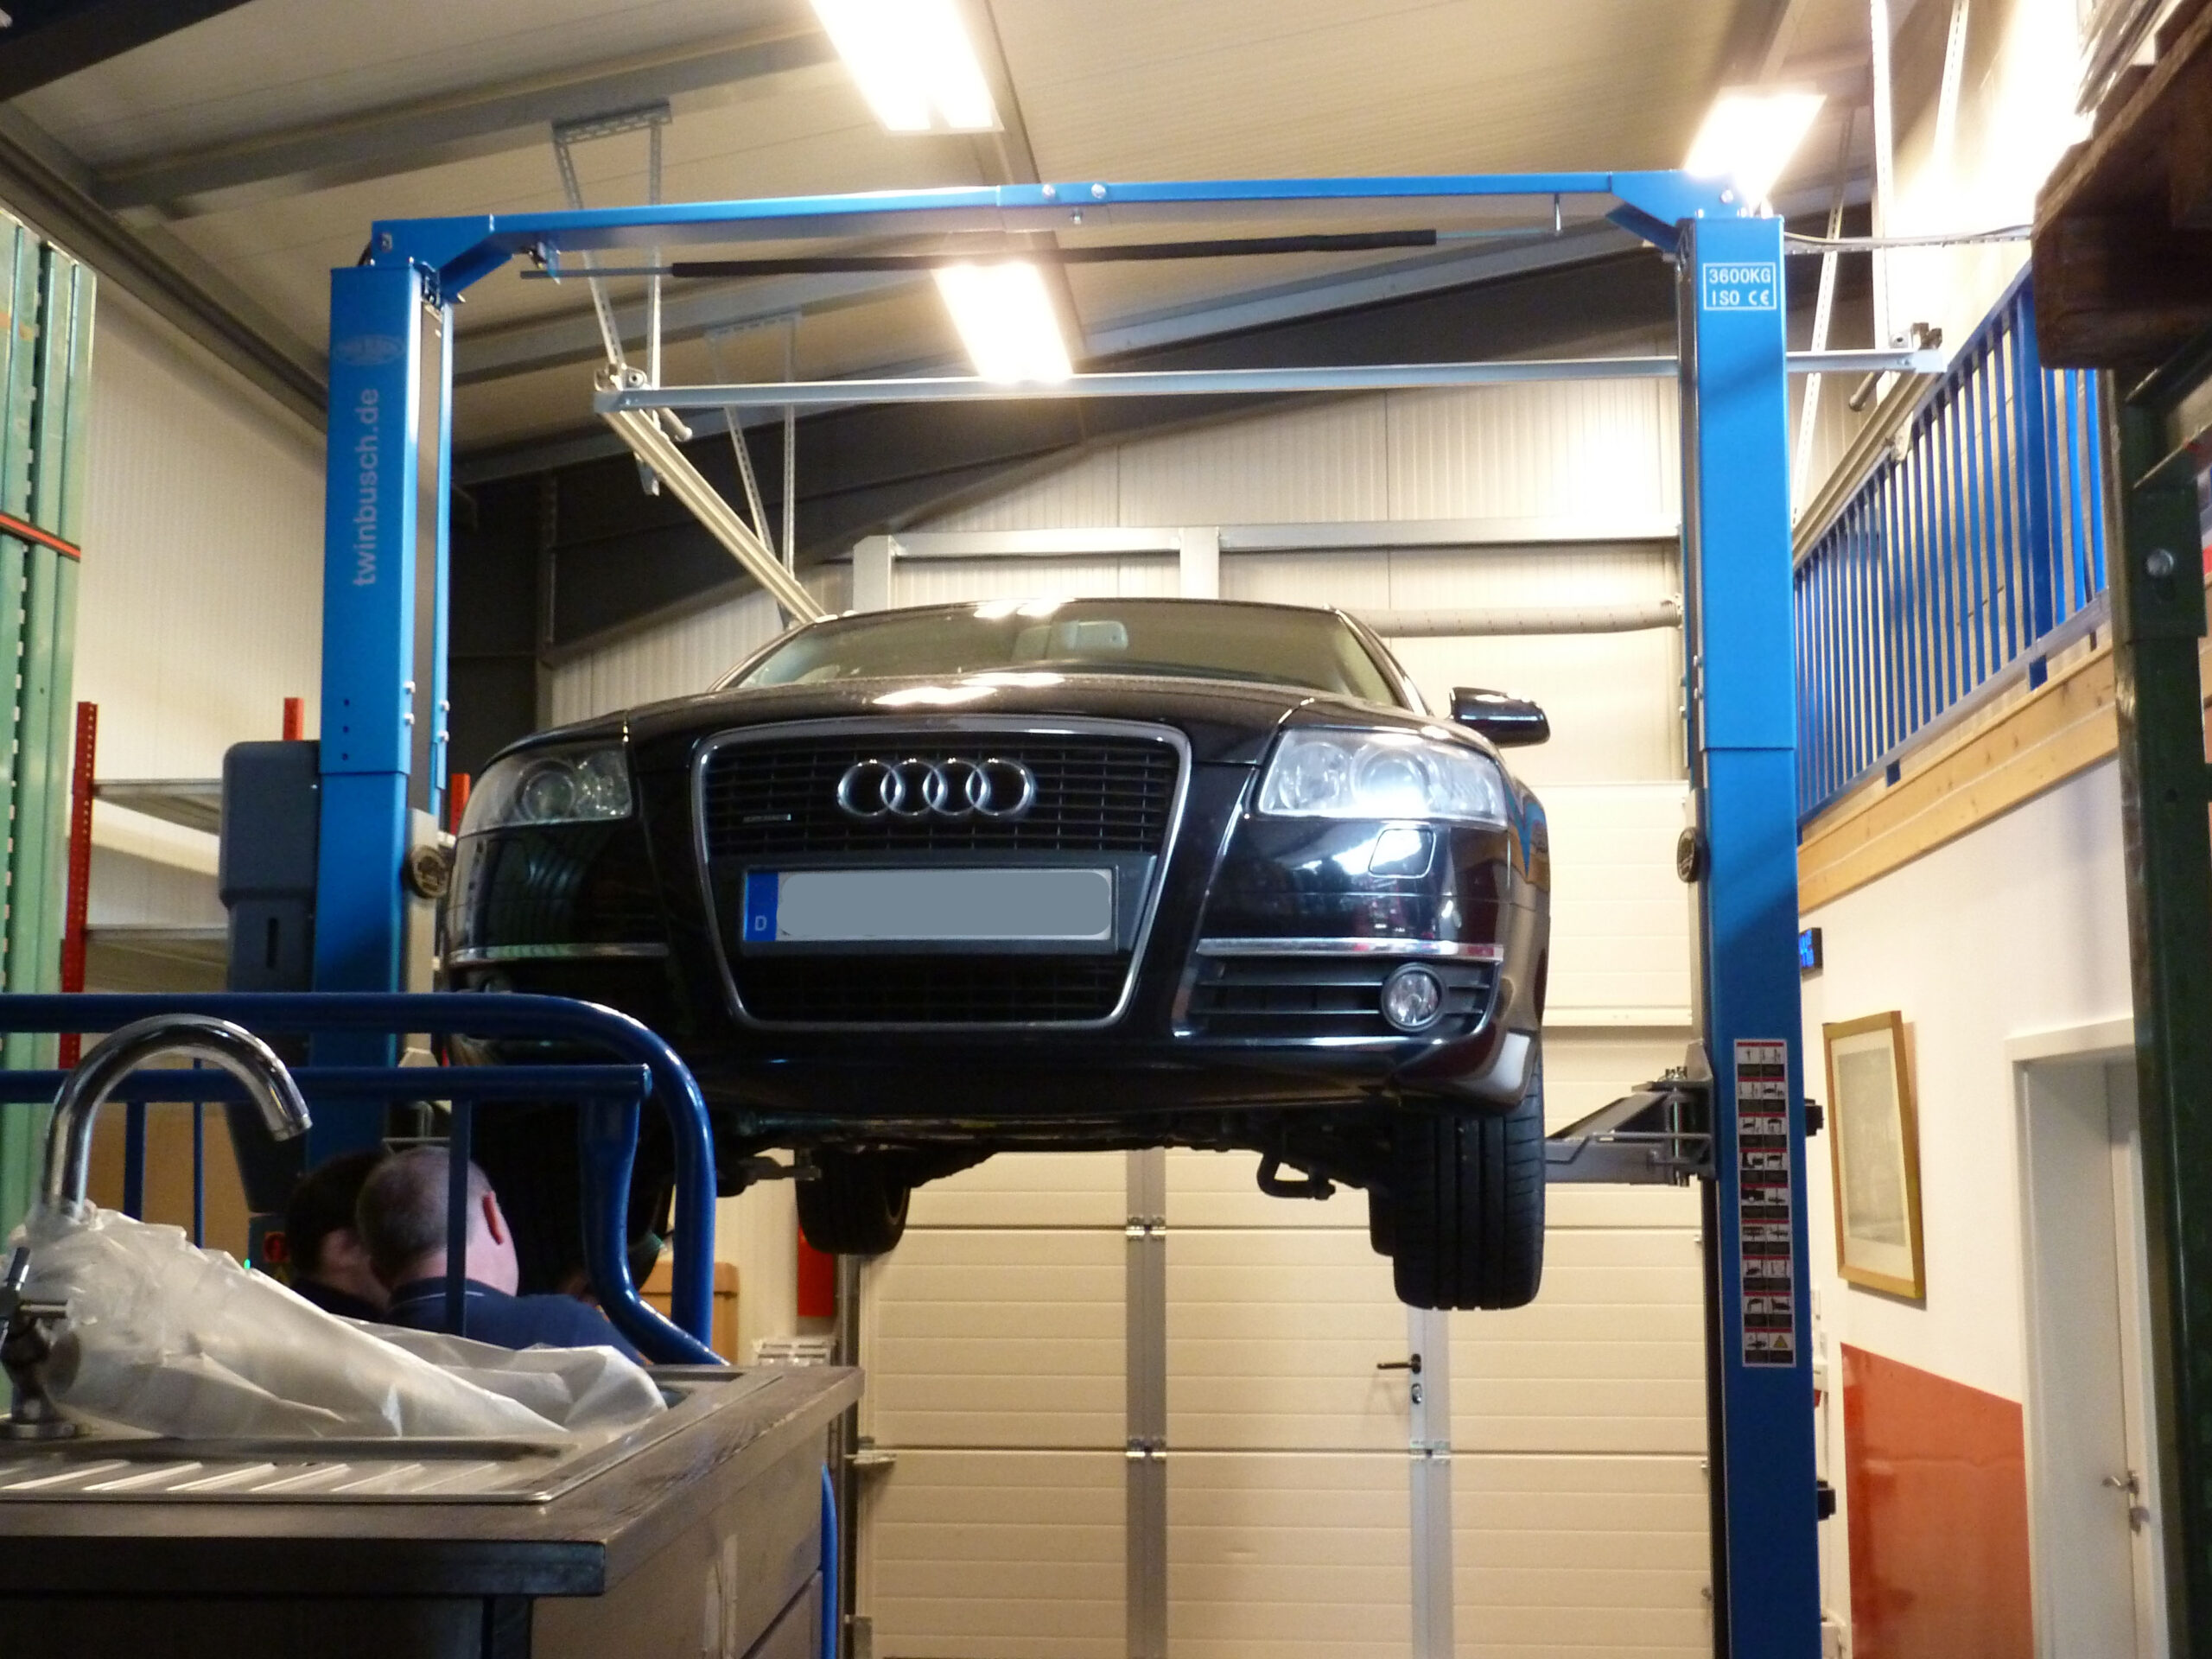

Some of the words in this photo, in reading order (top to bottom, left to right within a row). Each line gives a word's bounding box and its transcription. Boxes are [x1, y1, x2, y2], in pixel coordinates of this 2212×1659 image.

[1709, 267, 1771, 284] 3600KG
[1713, 289, 1740, 306] ISO
[353, 388, 378, 587] twinbusch.de
[754, 915, 767, 931] D
